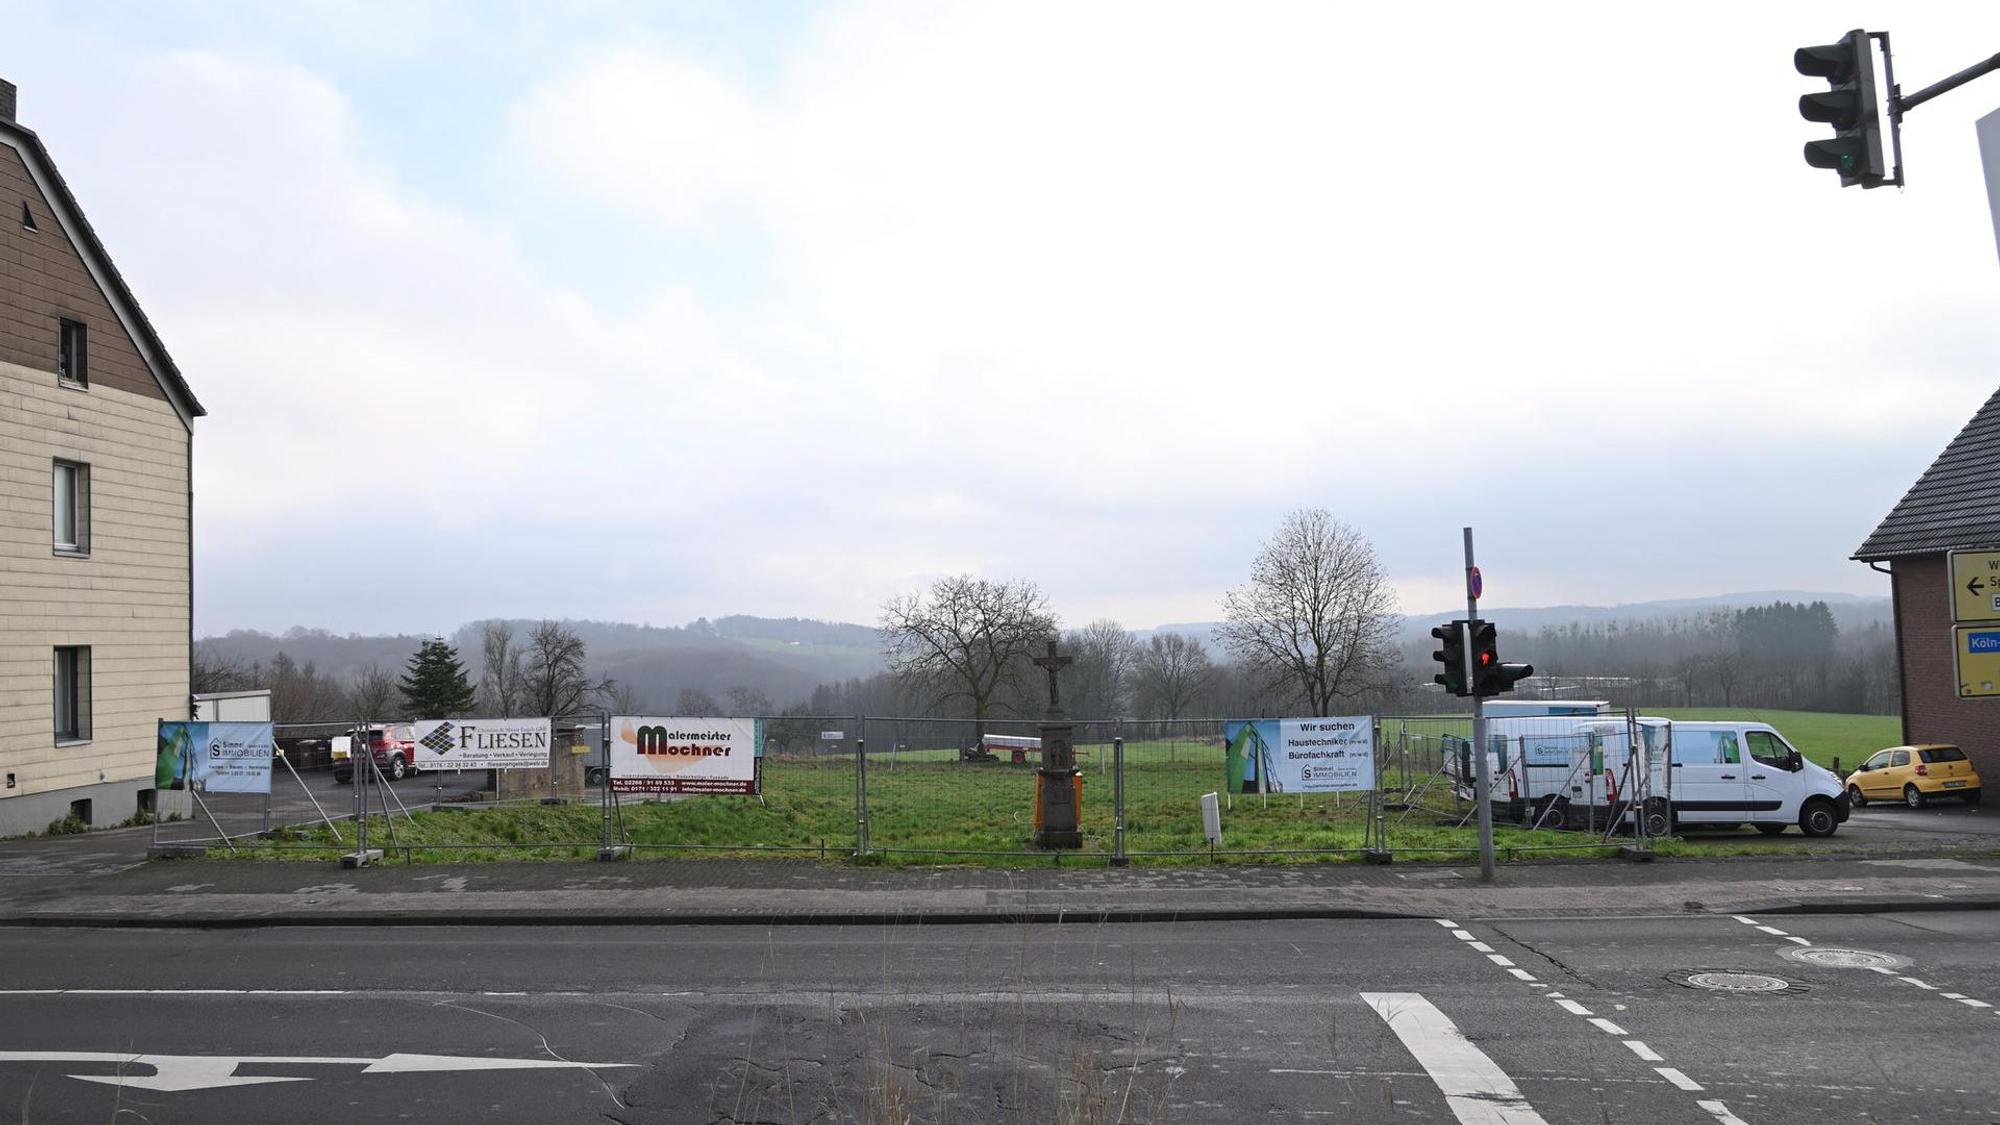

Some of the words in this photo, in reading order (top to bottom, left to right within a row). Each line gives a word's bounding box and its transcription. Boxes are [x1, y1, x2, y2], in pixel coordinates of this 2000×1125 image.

[1300, 723, 1317, 732] Wir
[1320, 722, 1355, 732] suchen
[460, 726, 547, 749] FLIESEN
[637, 725, 731, 741] Malermeister
[1288, 738, 1348, 748] Haustechniker
[637, 742, 731, 757] Mochner
[1288, 750, 1345, 760] Bürofachkraft
[1304, 769, 1312, 779] S
